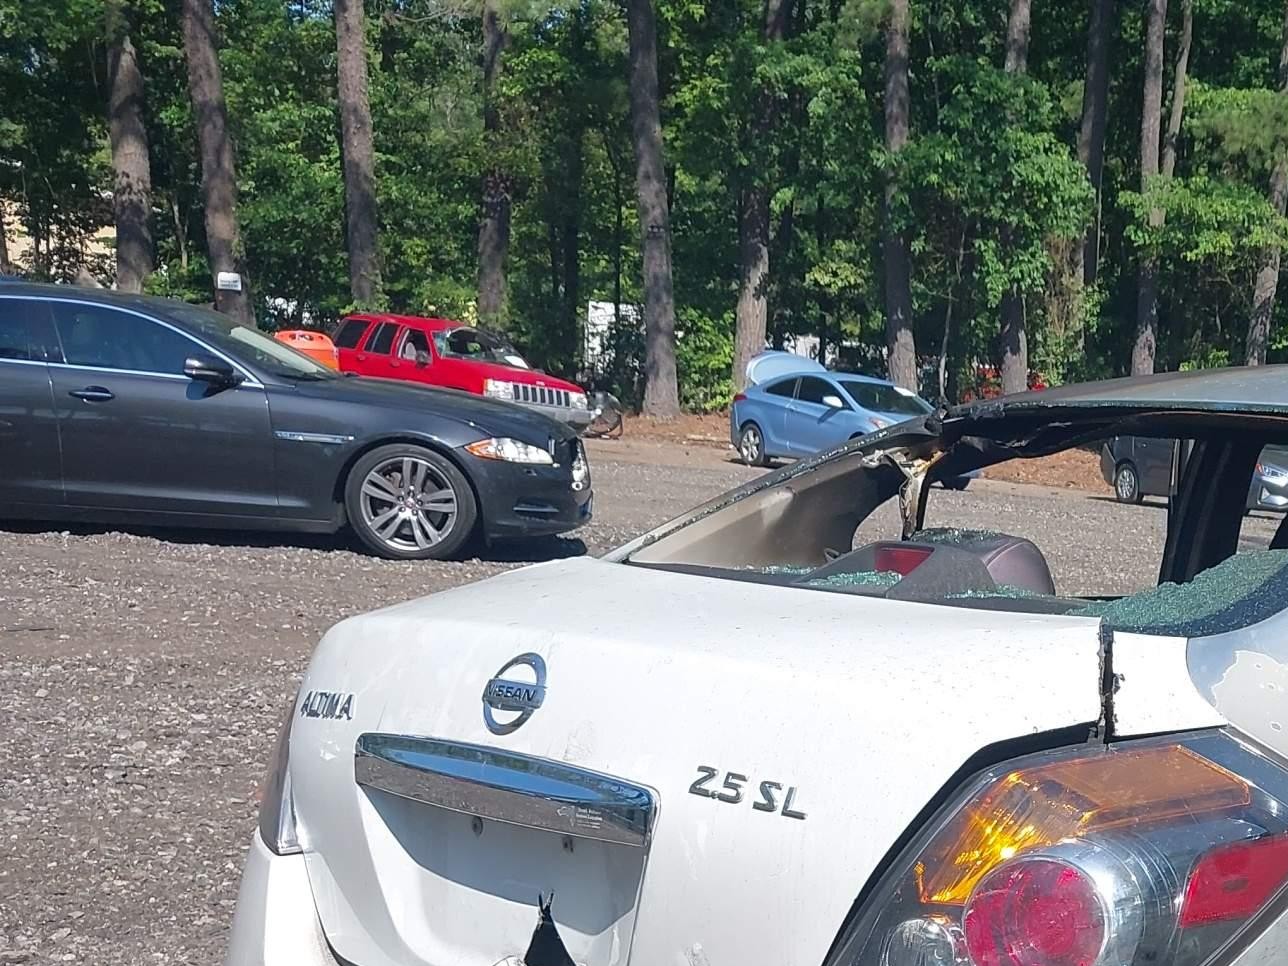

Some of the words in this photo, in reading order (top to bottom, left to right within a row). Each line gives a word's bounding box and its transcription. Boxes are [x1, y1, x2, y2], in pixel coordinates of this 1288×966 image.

[300, 690, 353, 721] ALTIMA
[486, 683, 537, 702] NISSAN
[688, 765, 749, 805] 2.5
[752, 780, 808, 821] SL
